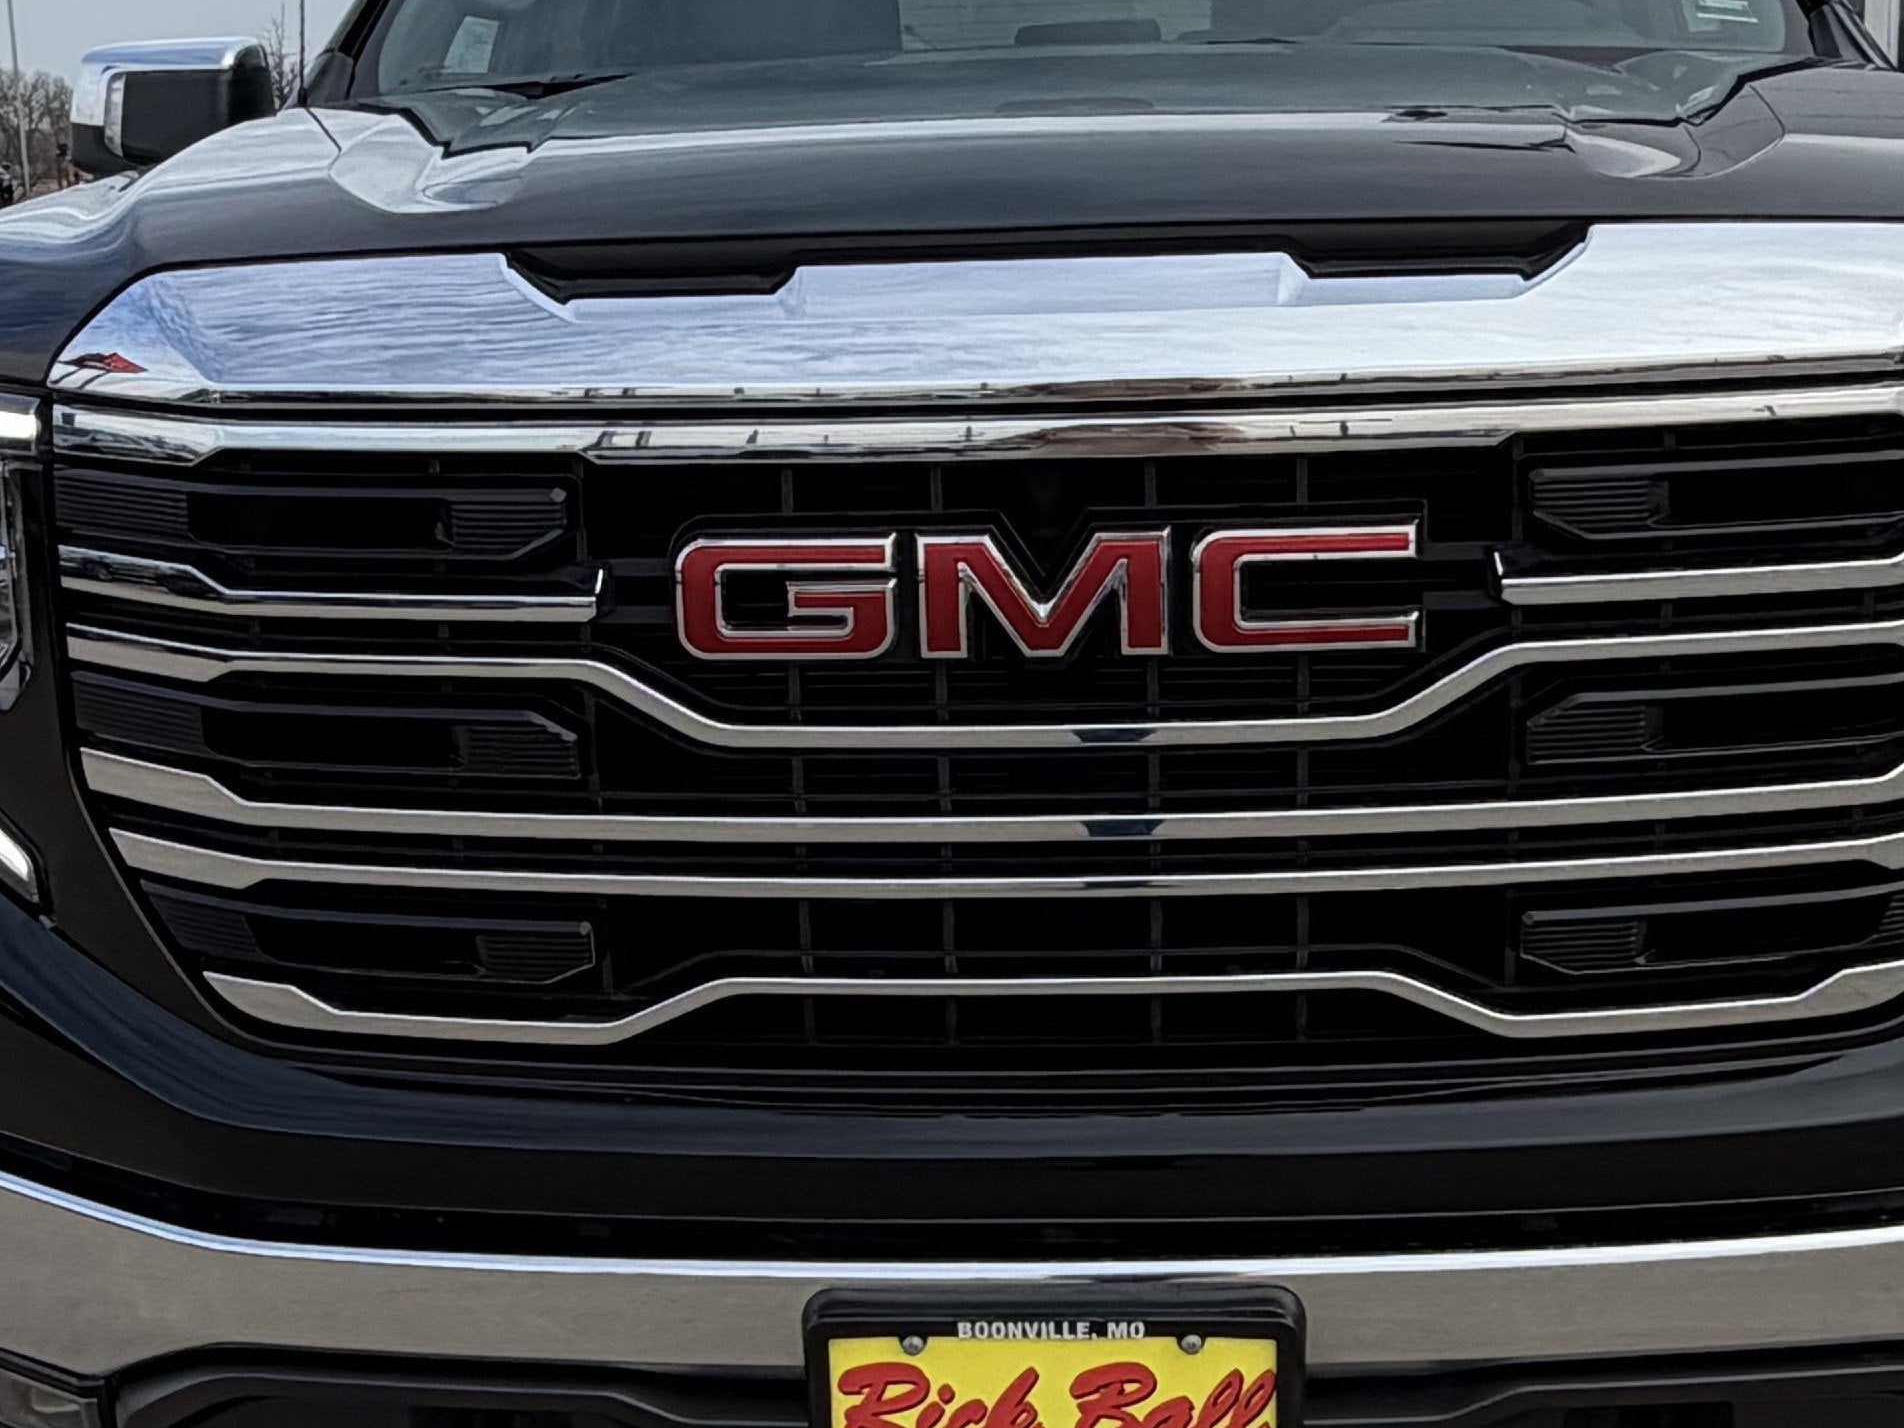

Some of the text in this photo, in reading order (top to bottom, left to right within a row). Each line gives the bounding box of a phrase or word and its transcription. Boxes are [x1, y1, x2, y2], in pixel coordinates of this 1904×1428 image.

[675, 520, 1421, 660] GMC
[957, 1321, 1146, 1341] BOONVILLE, MO
